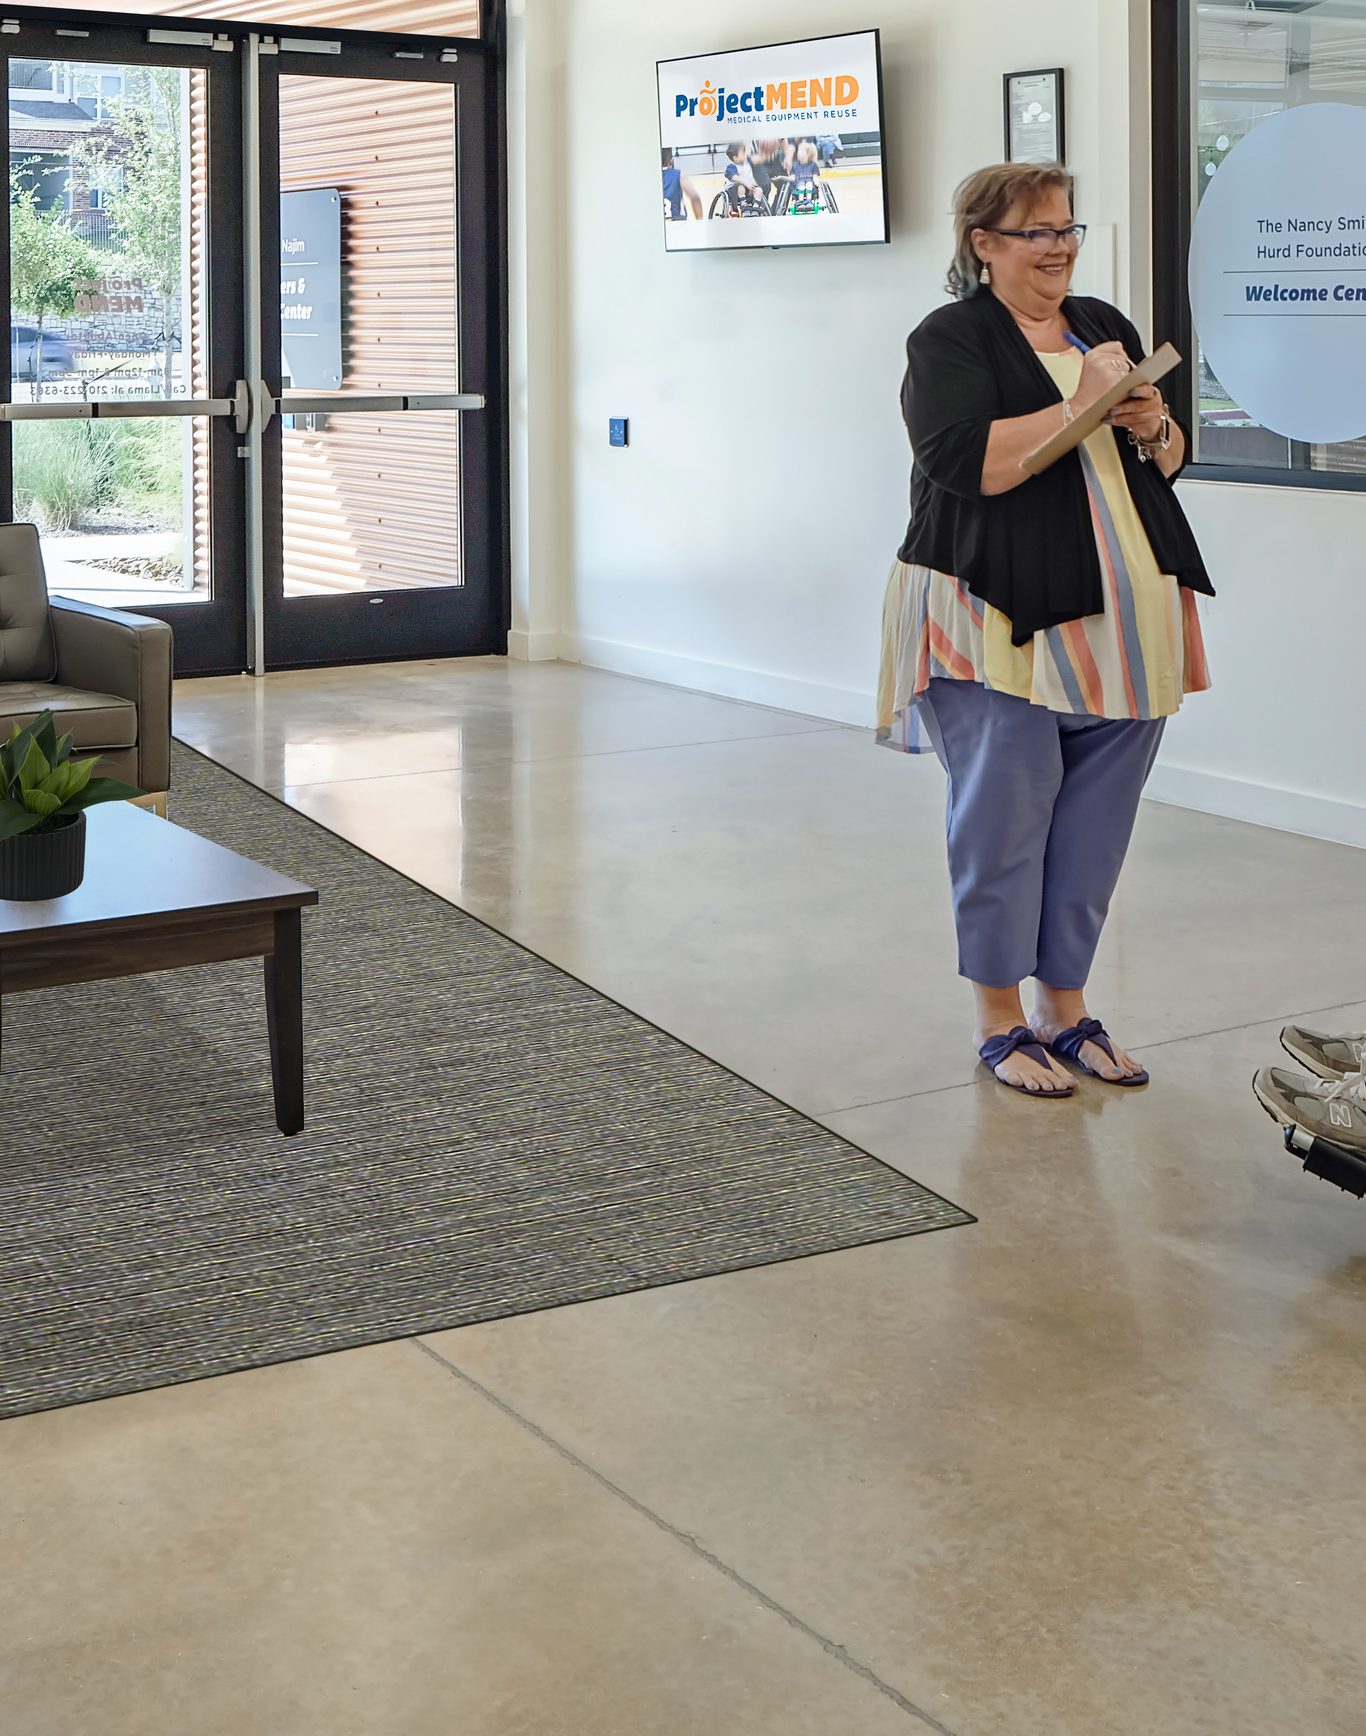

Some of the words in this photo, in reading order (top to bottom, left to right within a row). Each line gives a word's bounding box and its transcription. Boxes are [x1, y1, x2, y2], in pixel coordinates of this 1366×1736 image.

[727, 116, 761, 124] MEDICAL
[766, 112, 817, 122] EQUIPMENT
[823, 109, 856, 118] REUSE
[1257, 219, 1282, 233] The
[1288, 218, 1332, 233] Nancy
[282, 238, 304, 255] Najim
[1257, 244, 1291, 258] Hurd
[298, 277, 305, 294] &
[1245, 285, 1328, 301] Welcome
[1329, 1103, 1352, 1128] N
